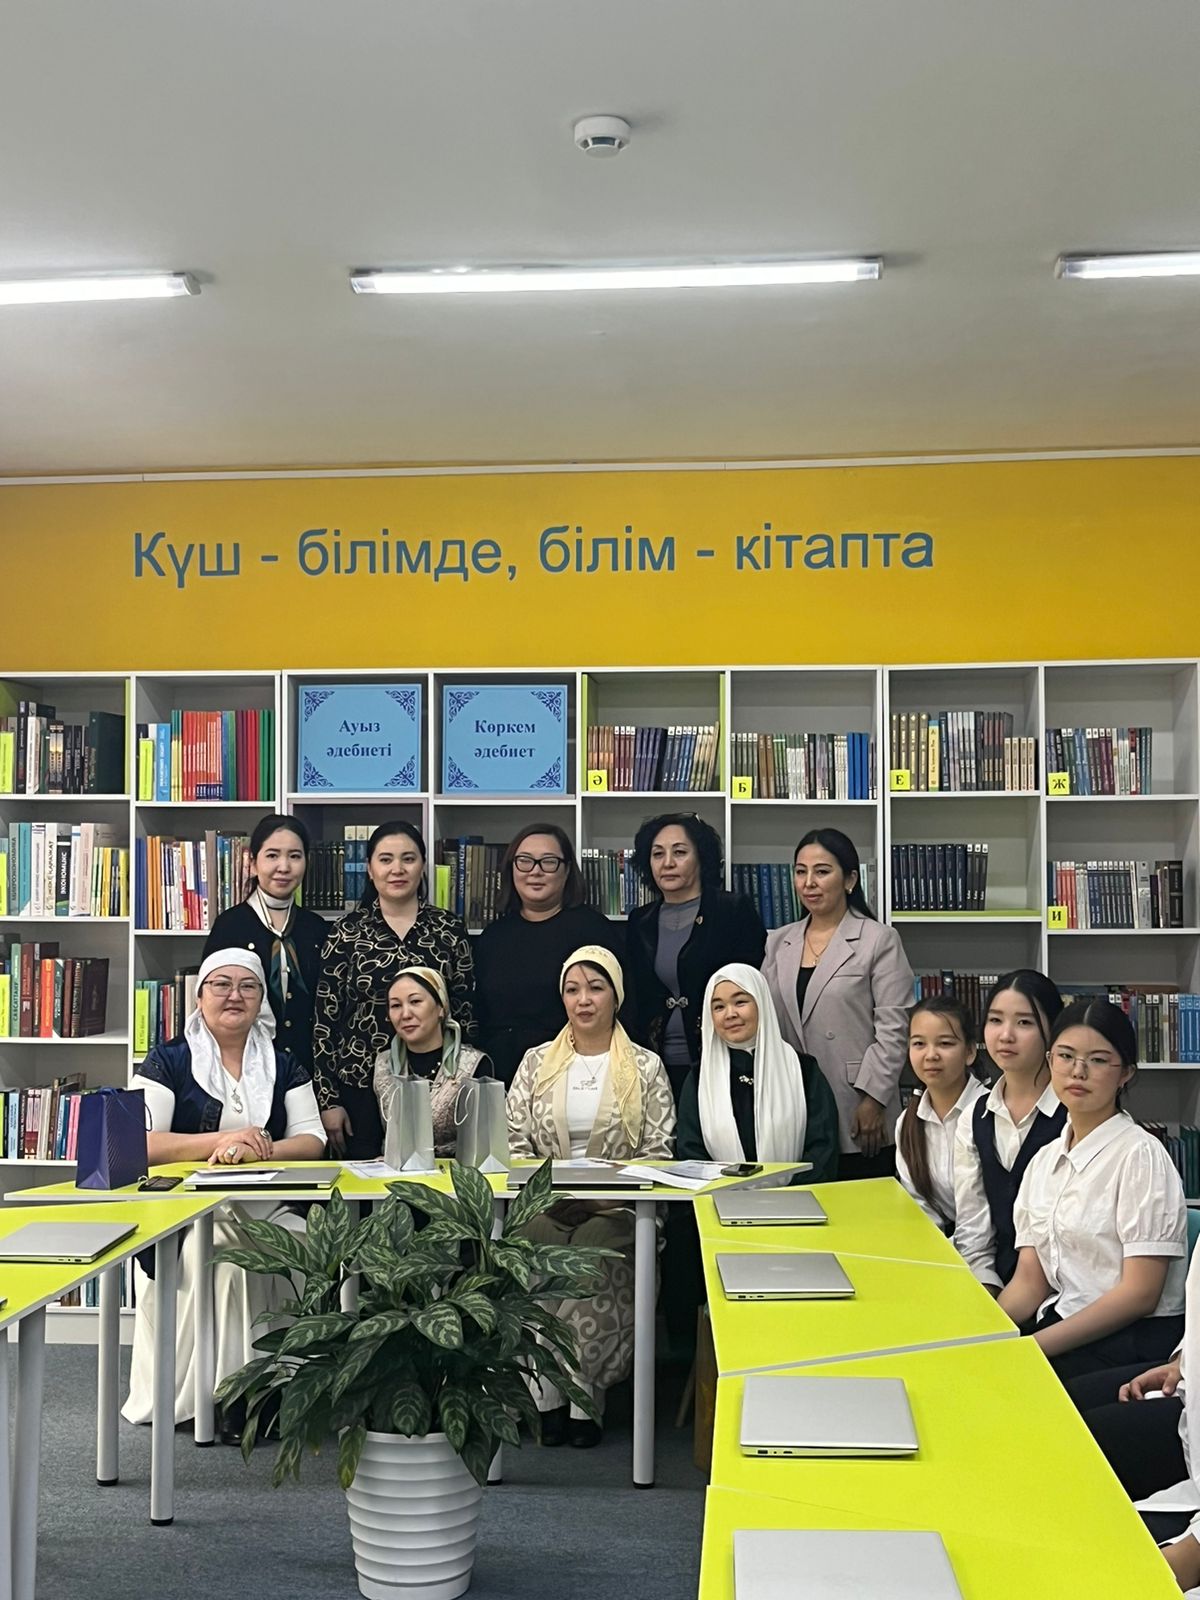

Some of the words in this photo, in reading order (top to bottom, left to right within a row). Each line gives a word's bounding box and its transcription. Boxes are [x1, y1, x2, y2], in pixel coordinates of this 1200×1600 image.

[133, 531, 241, 589] Күш
[298, 528, 516, 582] білімде,
[539, 526, 675, 574] білім
[736, 523, 933, 571] кітапта
[338, 719, 381, 736] Ауыз
[474, 719, 536, 737] Көркем
[326, 743, 392, 758] әдебиеті
[474, 744, 535, 759] әдебиет
[895, 774, 904, 785] Е
[1052, 778, 1067, 790] Ж
[738, 782, 747, 793] Б
[1052, 910, 1062, 922] И
